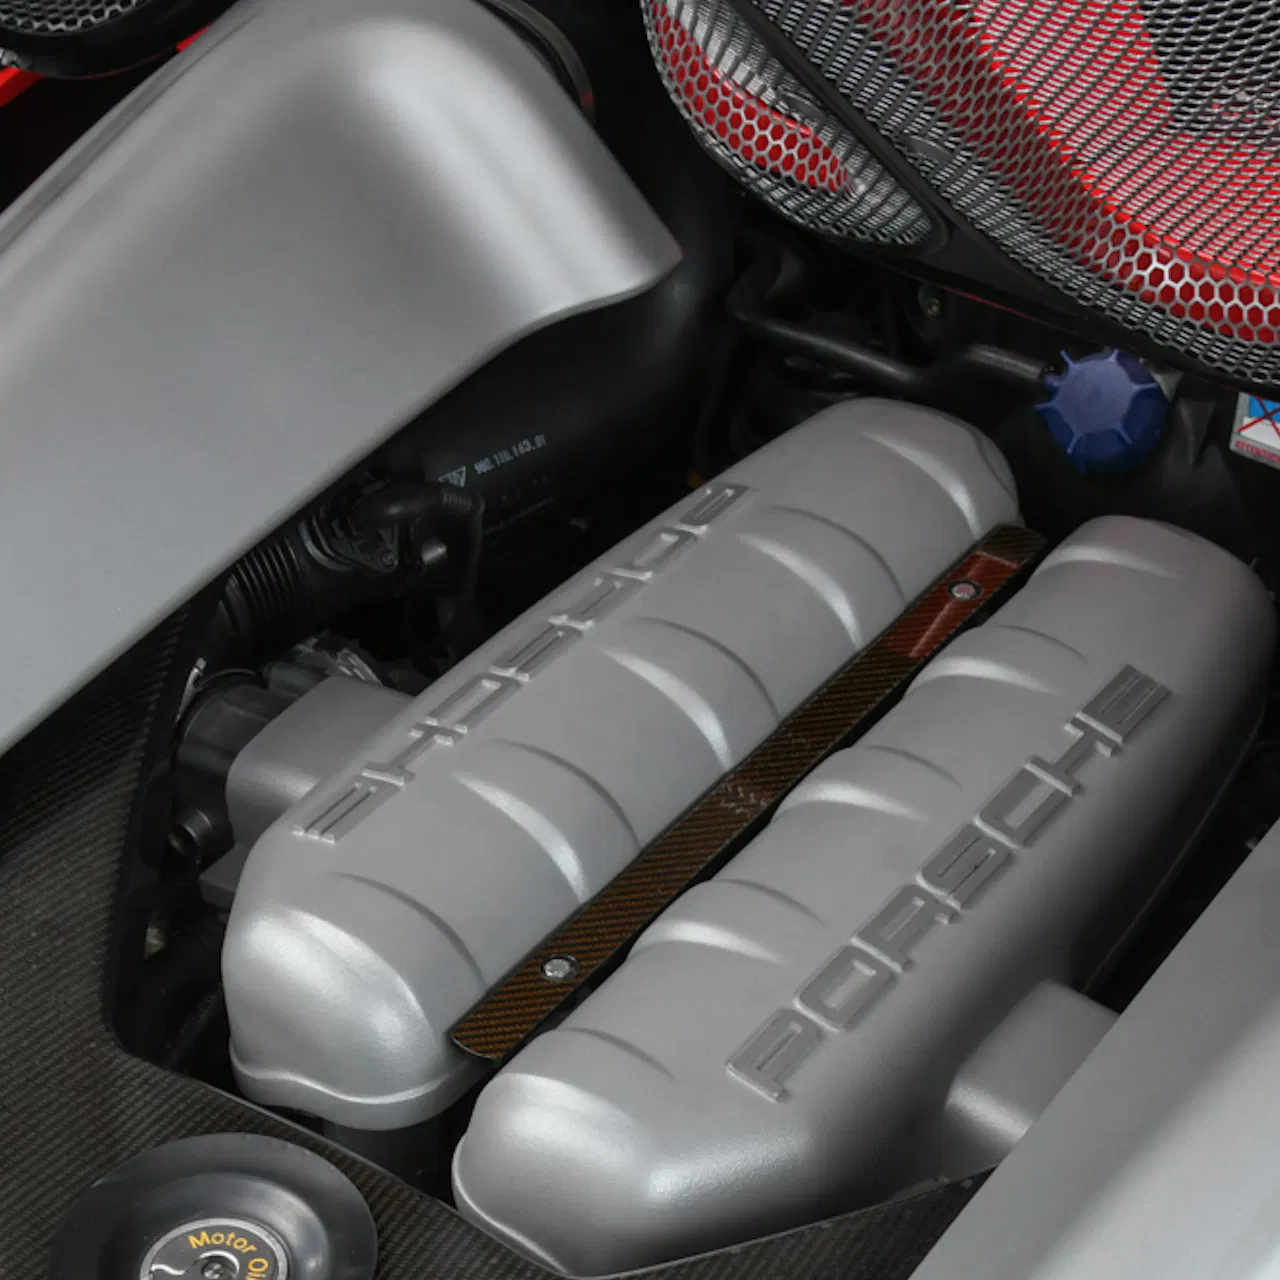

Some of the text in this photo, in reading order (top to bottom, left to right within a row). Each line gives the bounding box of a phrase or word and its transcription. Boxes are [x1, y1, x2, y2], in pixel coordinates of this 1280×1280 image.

[293, 484, 752, 844] PORSCHE
[726, 664, 1173, 1102] PORSCHE
[187, 1231, 257, 1253] Motor
